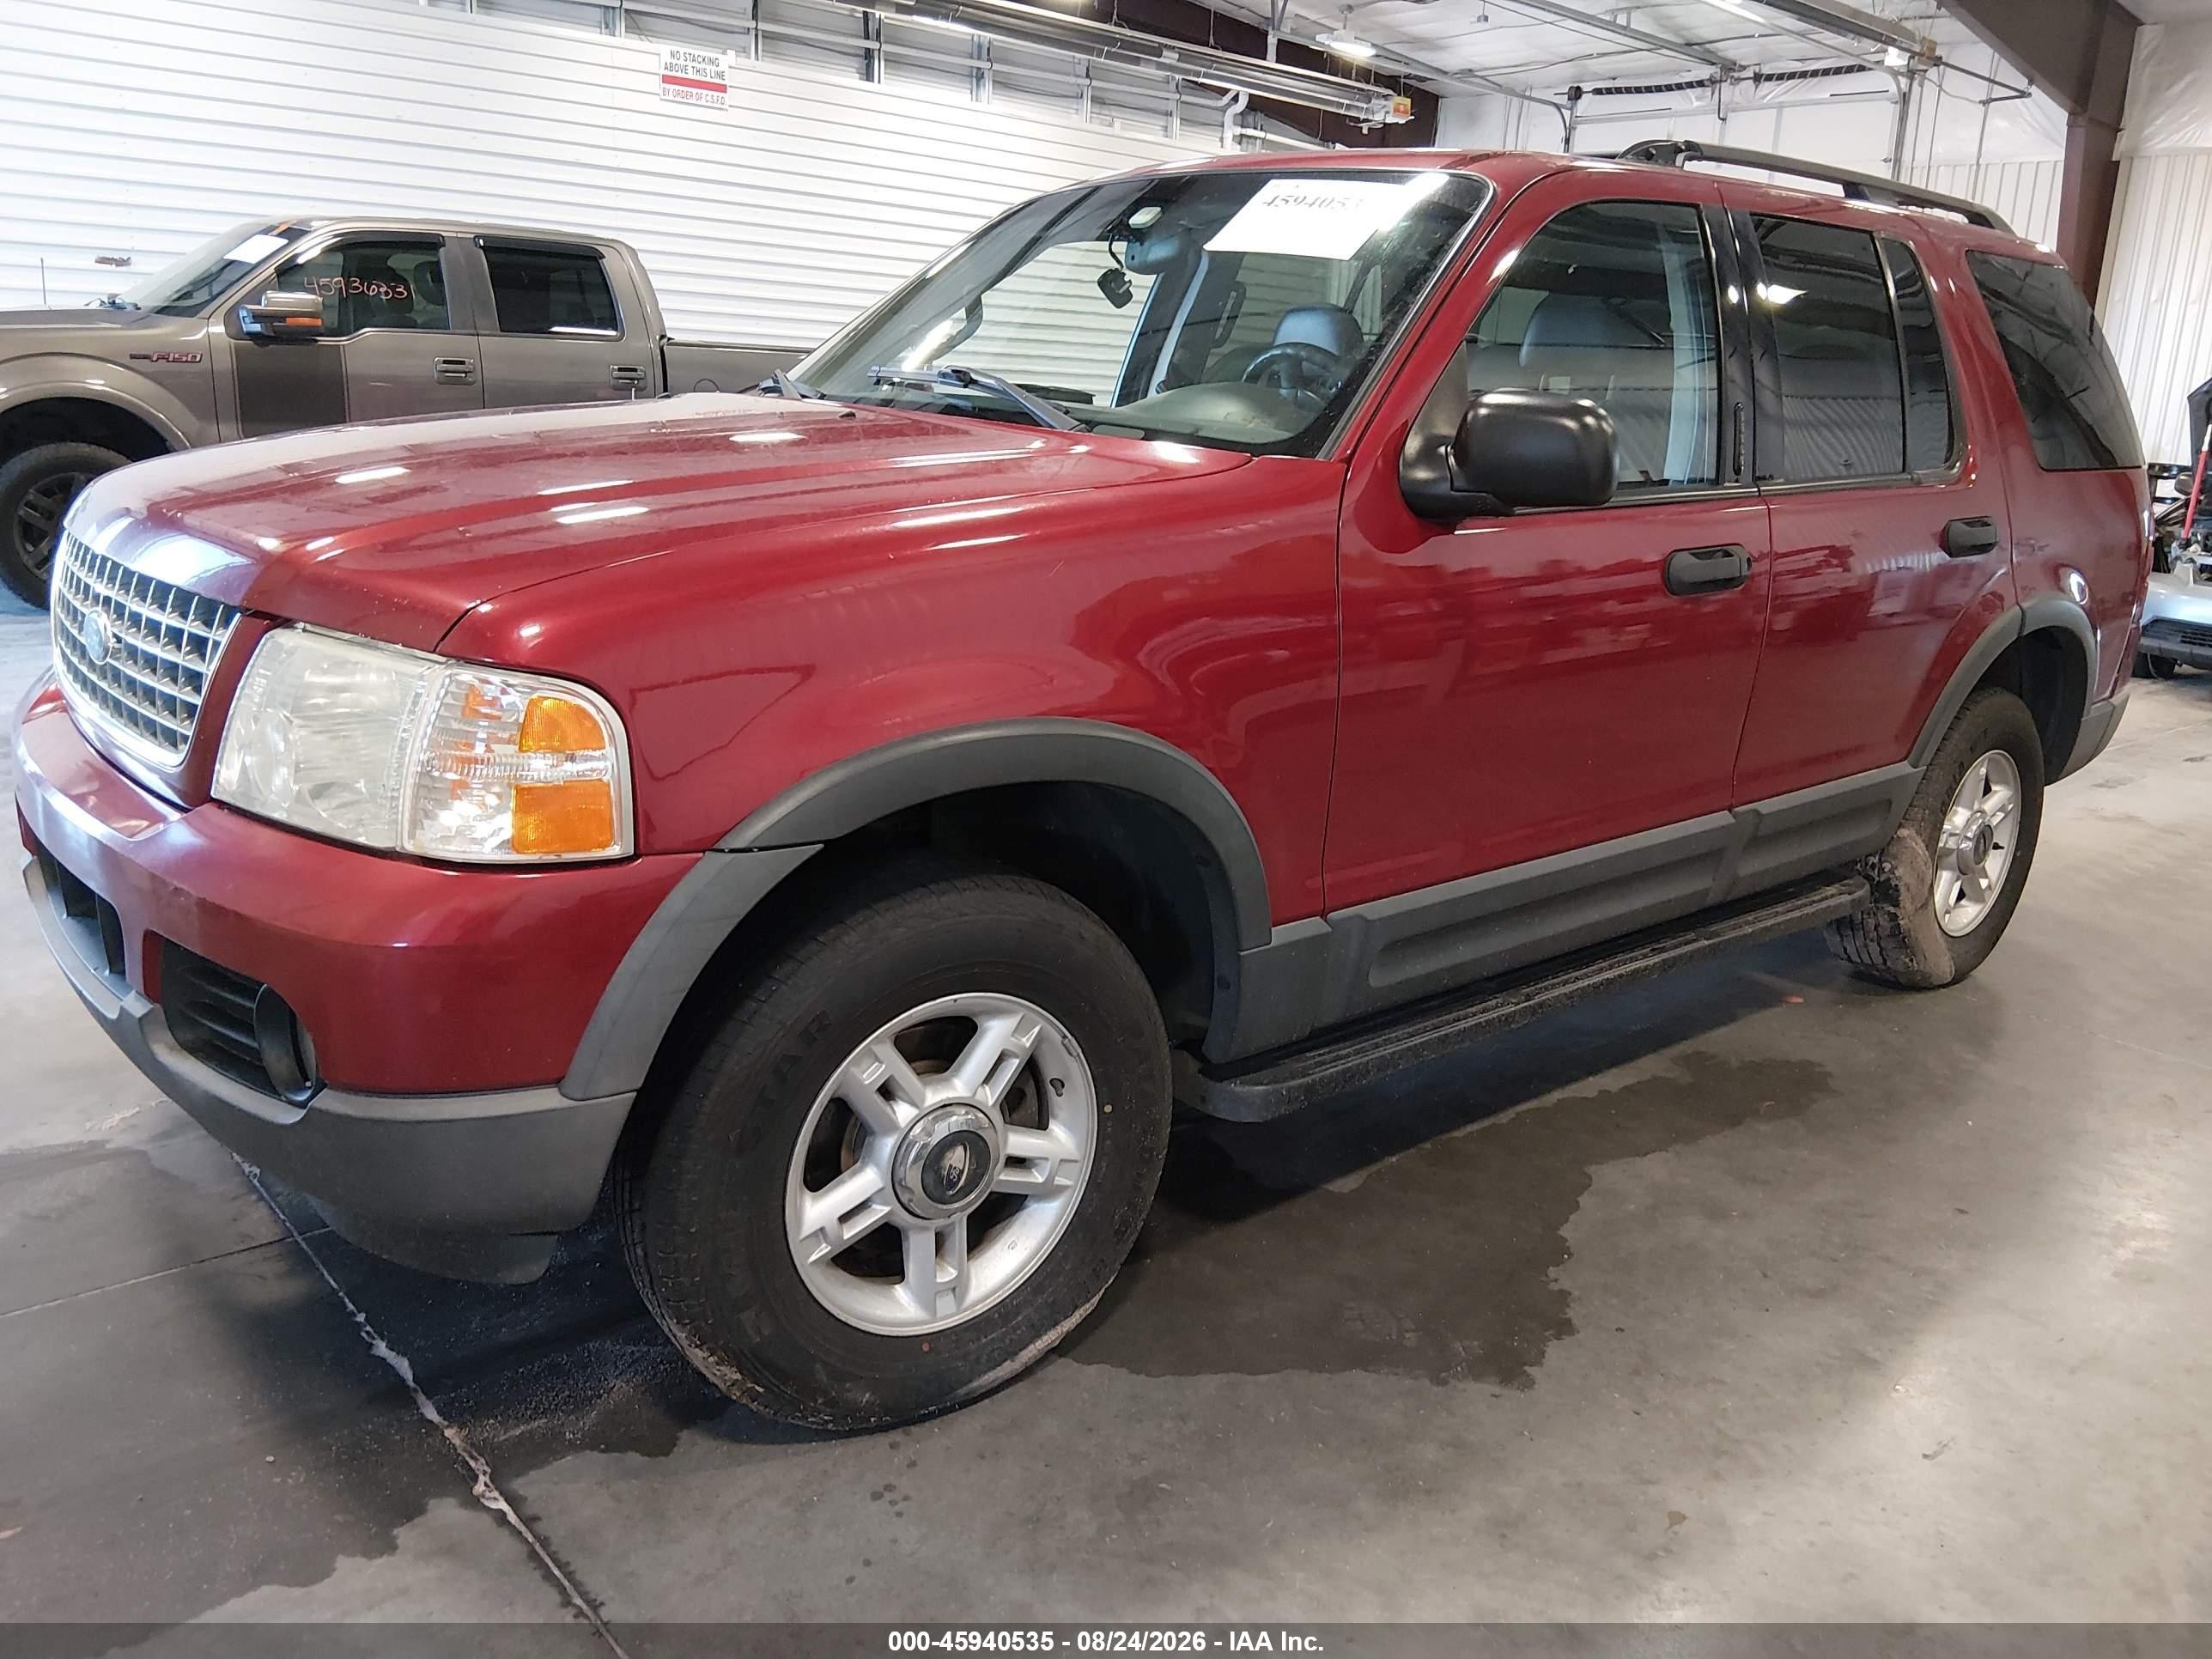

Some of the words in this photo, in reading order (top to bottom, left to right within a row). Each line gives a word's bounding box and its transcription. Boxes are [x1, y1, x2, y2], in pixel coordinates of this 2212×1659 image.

[670, 49, 681, 61] NO
[683, 52, 720, 68] STACKING
[664, 61, 689, 75] ABOVE
[691, 65, 708, 78] THIS
[709, 68, 726, 81] LINE
[662, 87, 671, 97] BY
[672, 88, 694, 100] ORDER
[695, 92, 703, 101] OF
